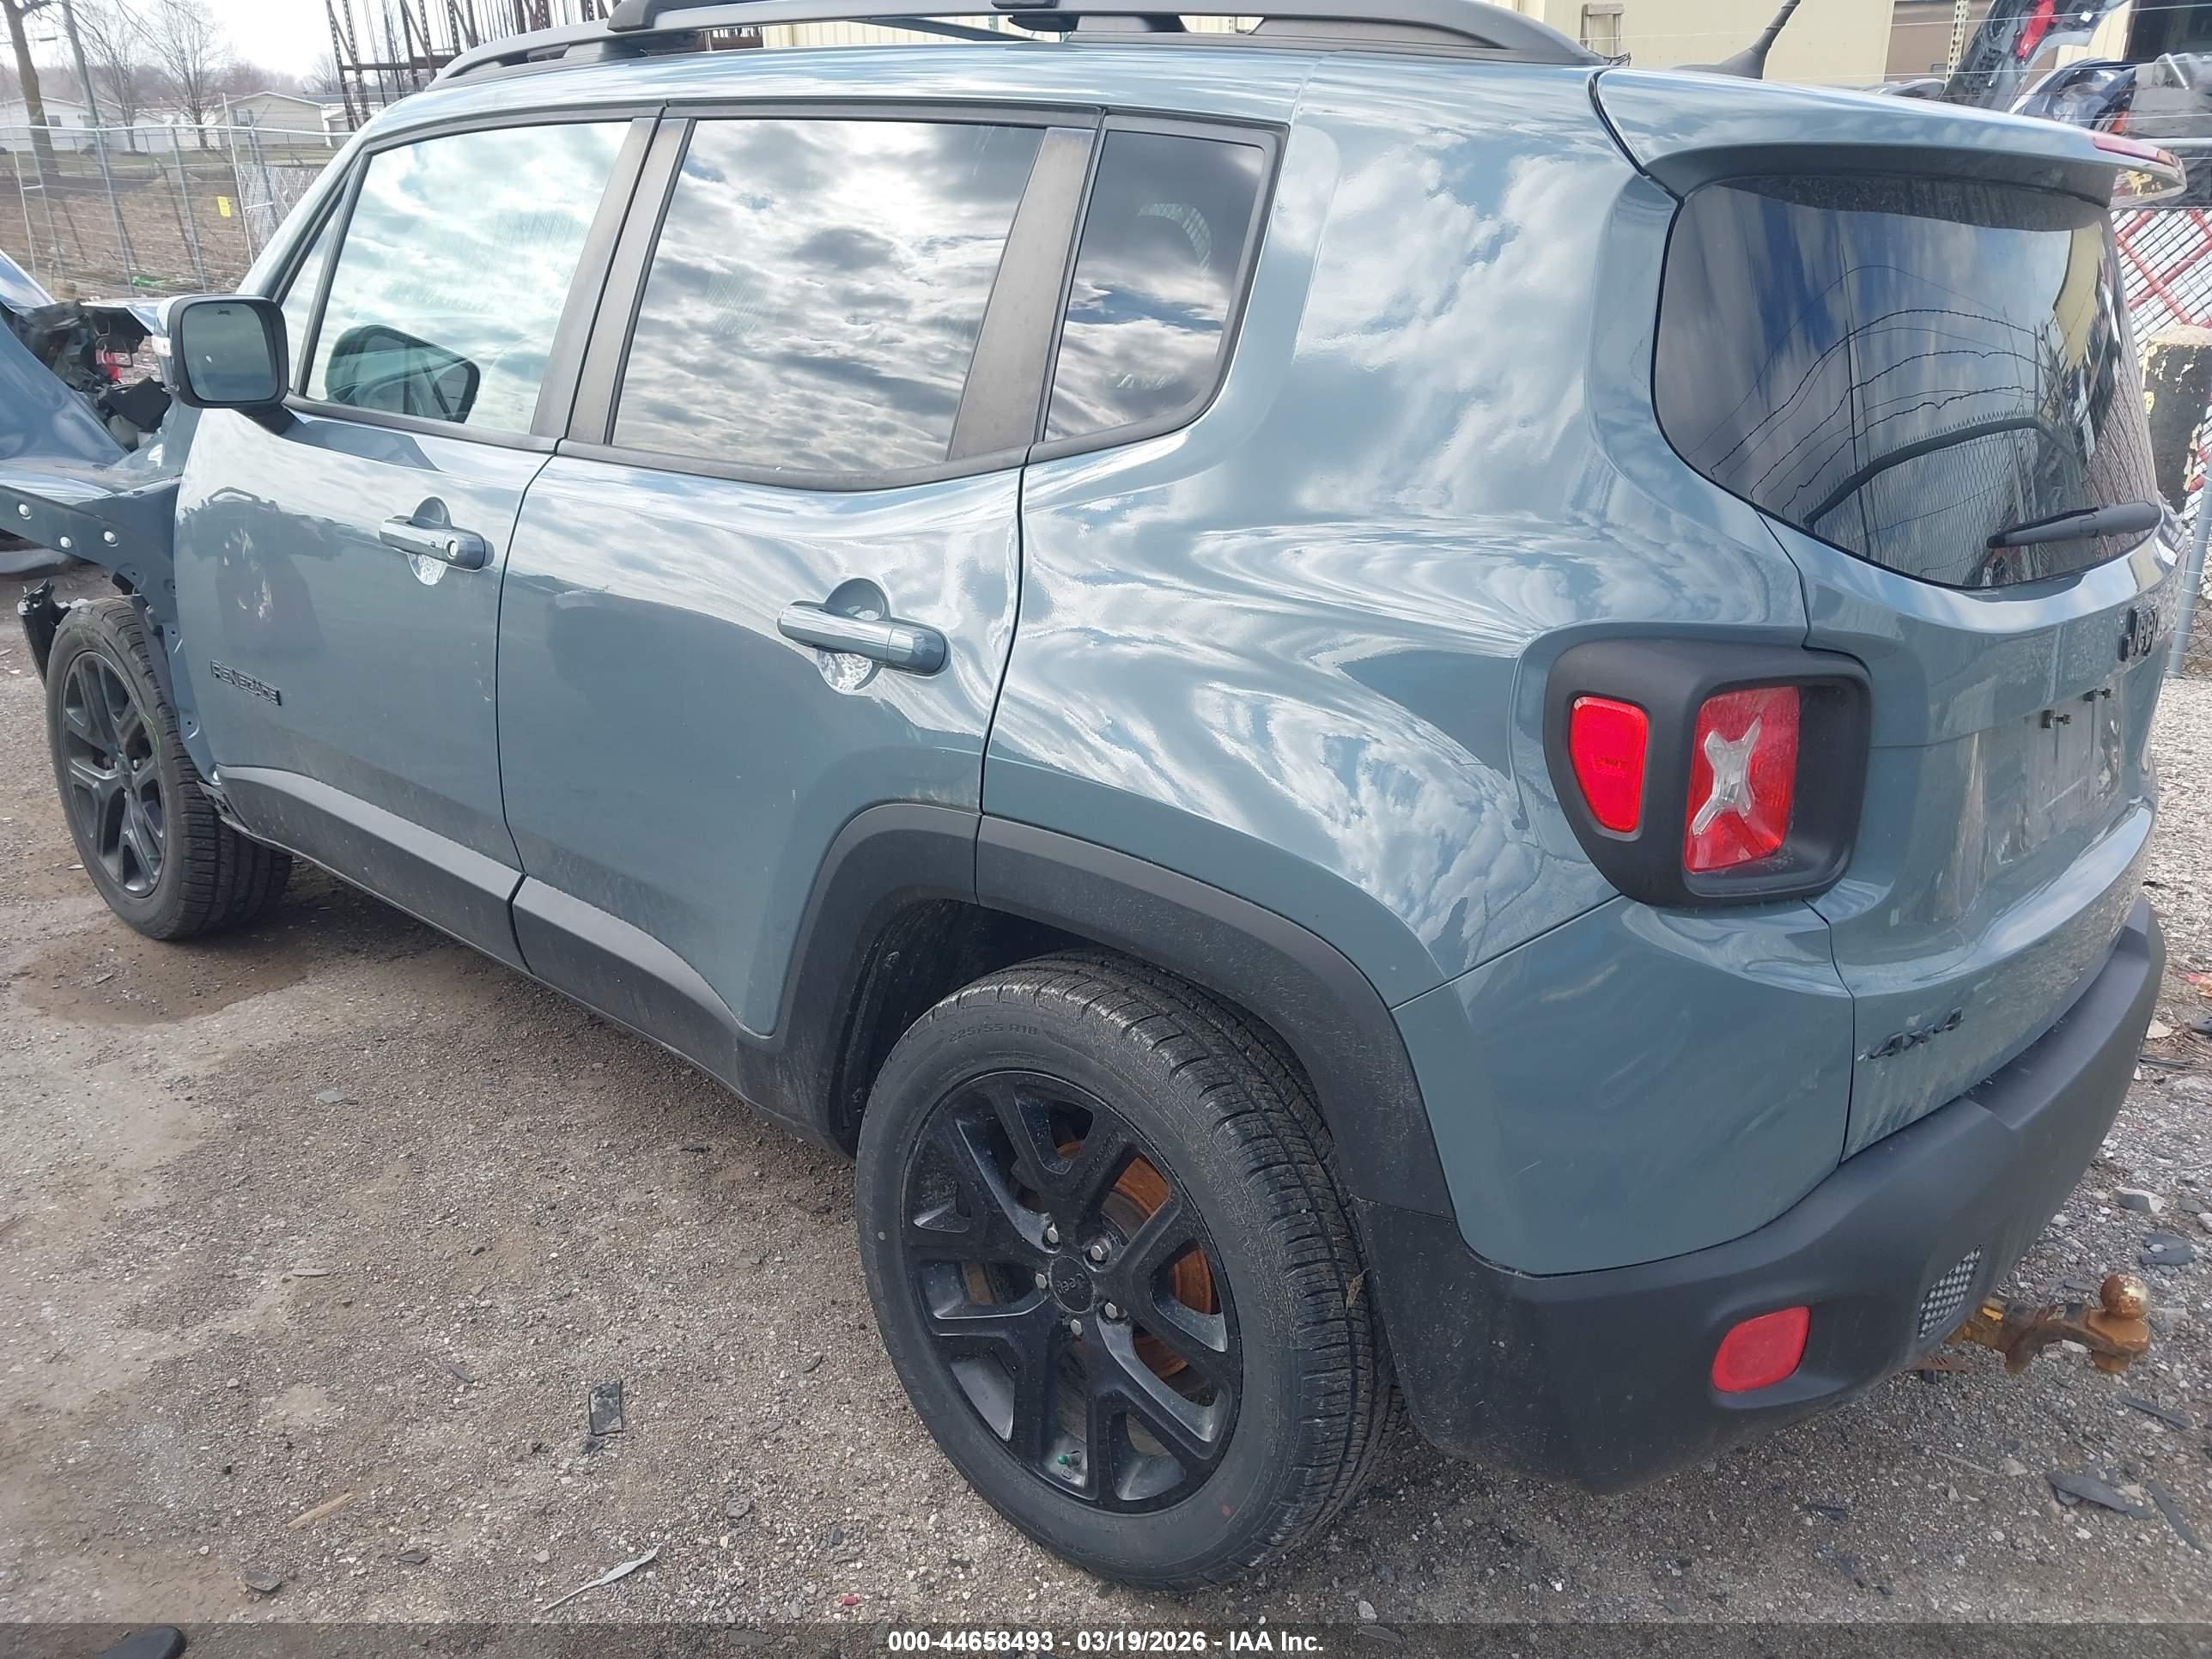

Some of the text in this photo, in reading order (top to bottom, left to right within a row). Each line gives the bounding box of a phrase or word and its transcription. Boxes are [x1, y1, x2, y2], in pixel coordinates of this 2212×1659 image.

[210, 659, 283, 707] RENEGADE
[948, 1022, 1039, 1044] 225/55 R18
